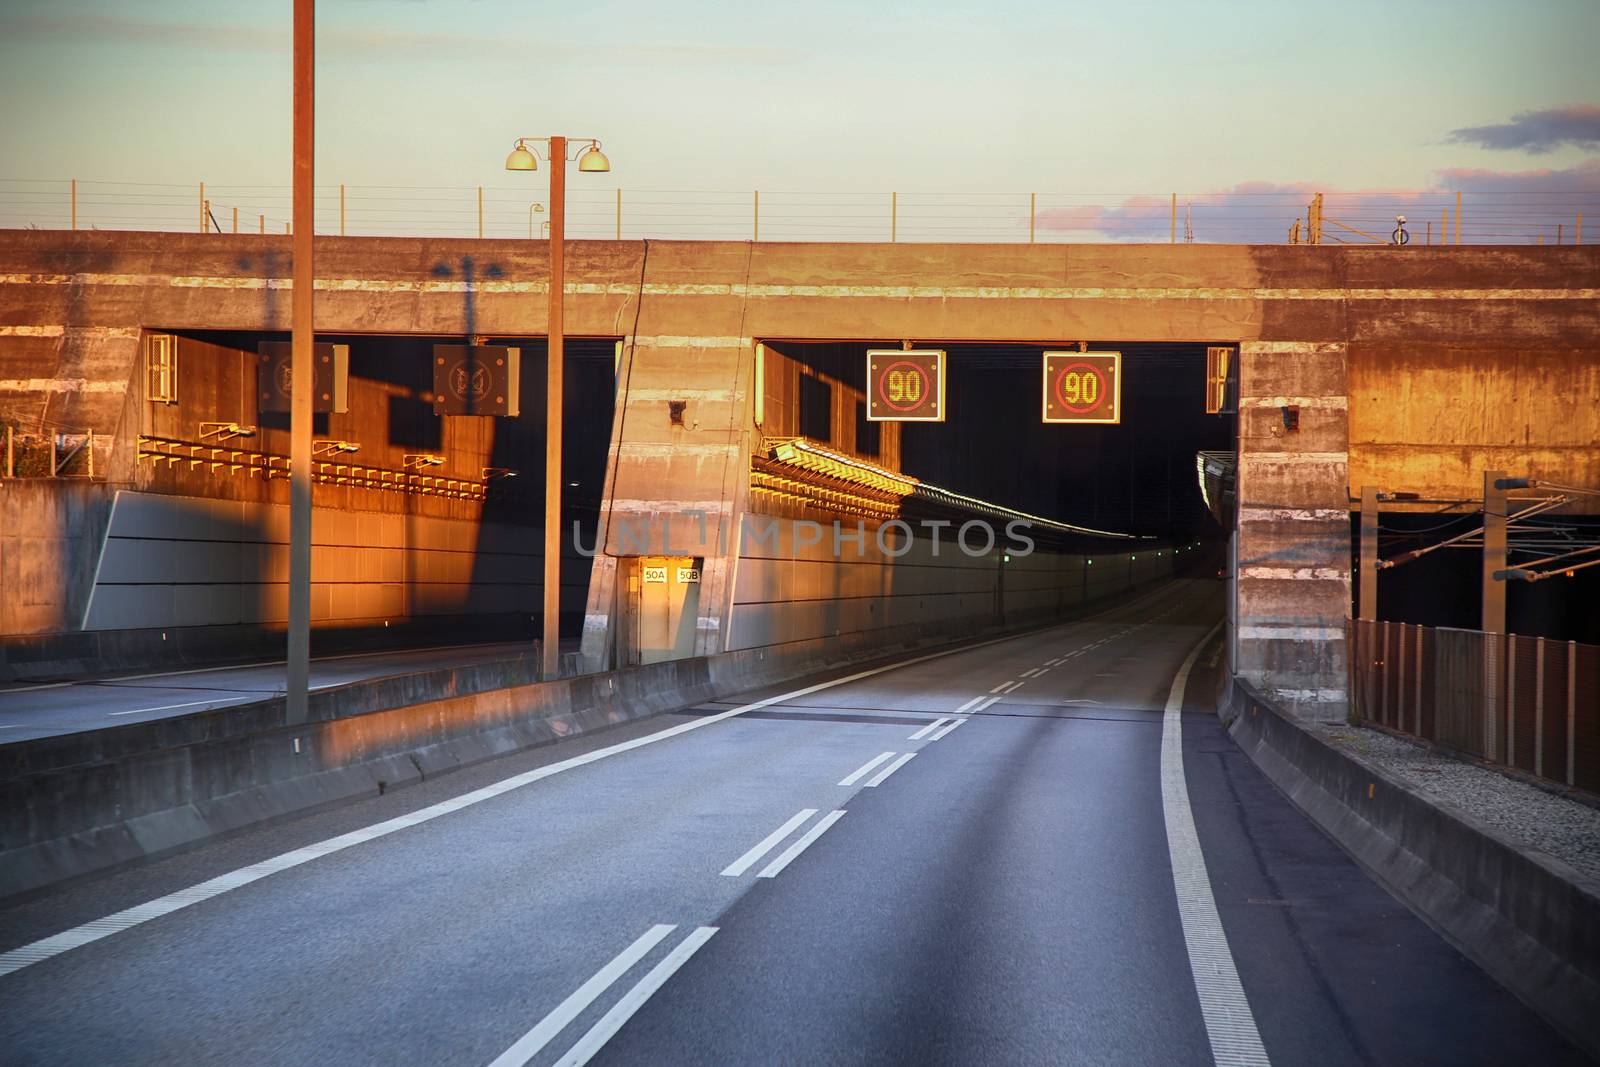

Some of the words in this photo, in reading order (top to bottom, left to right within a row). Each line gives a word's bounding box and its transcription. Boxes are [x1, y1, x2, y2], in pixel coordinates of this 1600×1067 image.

[888, 370, 921, 402] 90
[1065, 372, 1098, 403] 90
[645, 570, 665, 579] 50A
[680, 571, 698, 579] 50B
